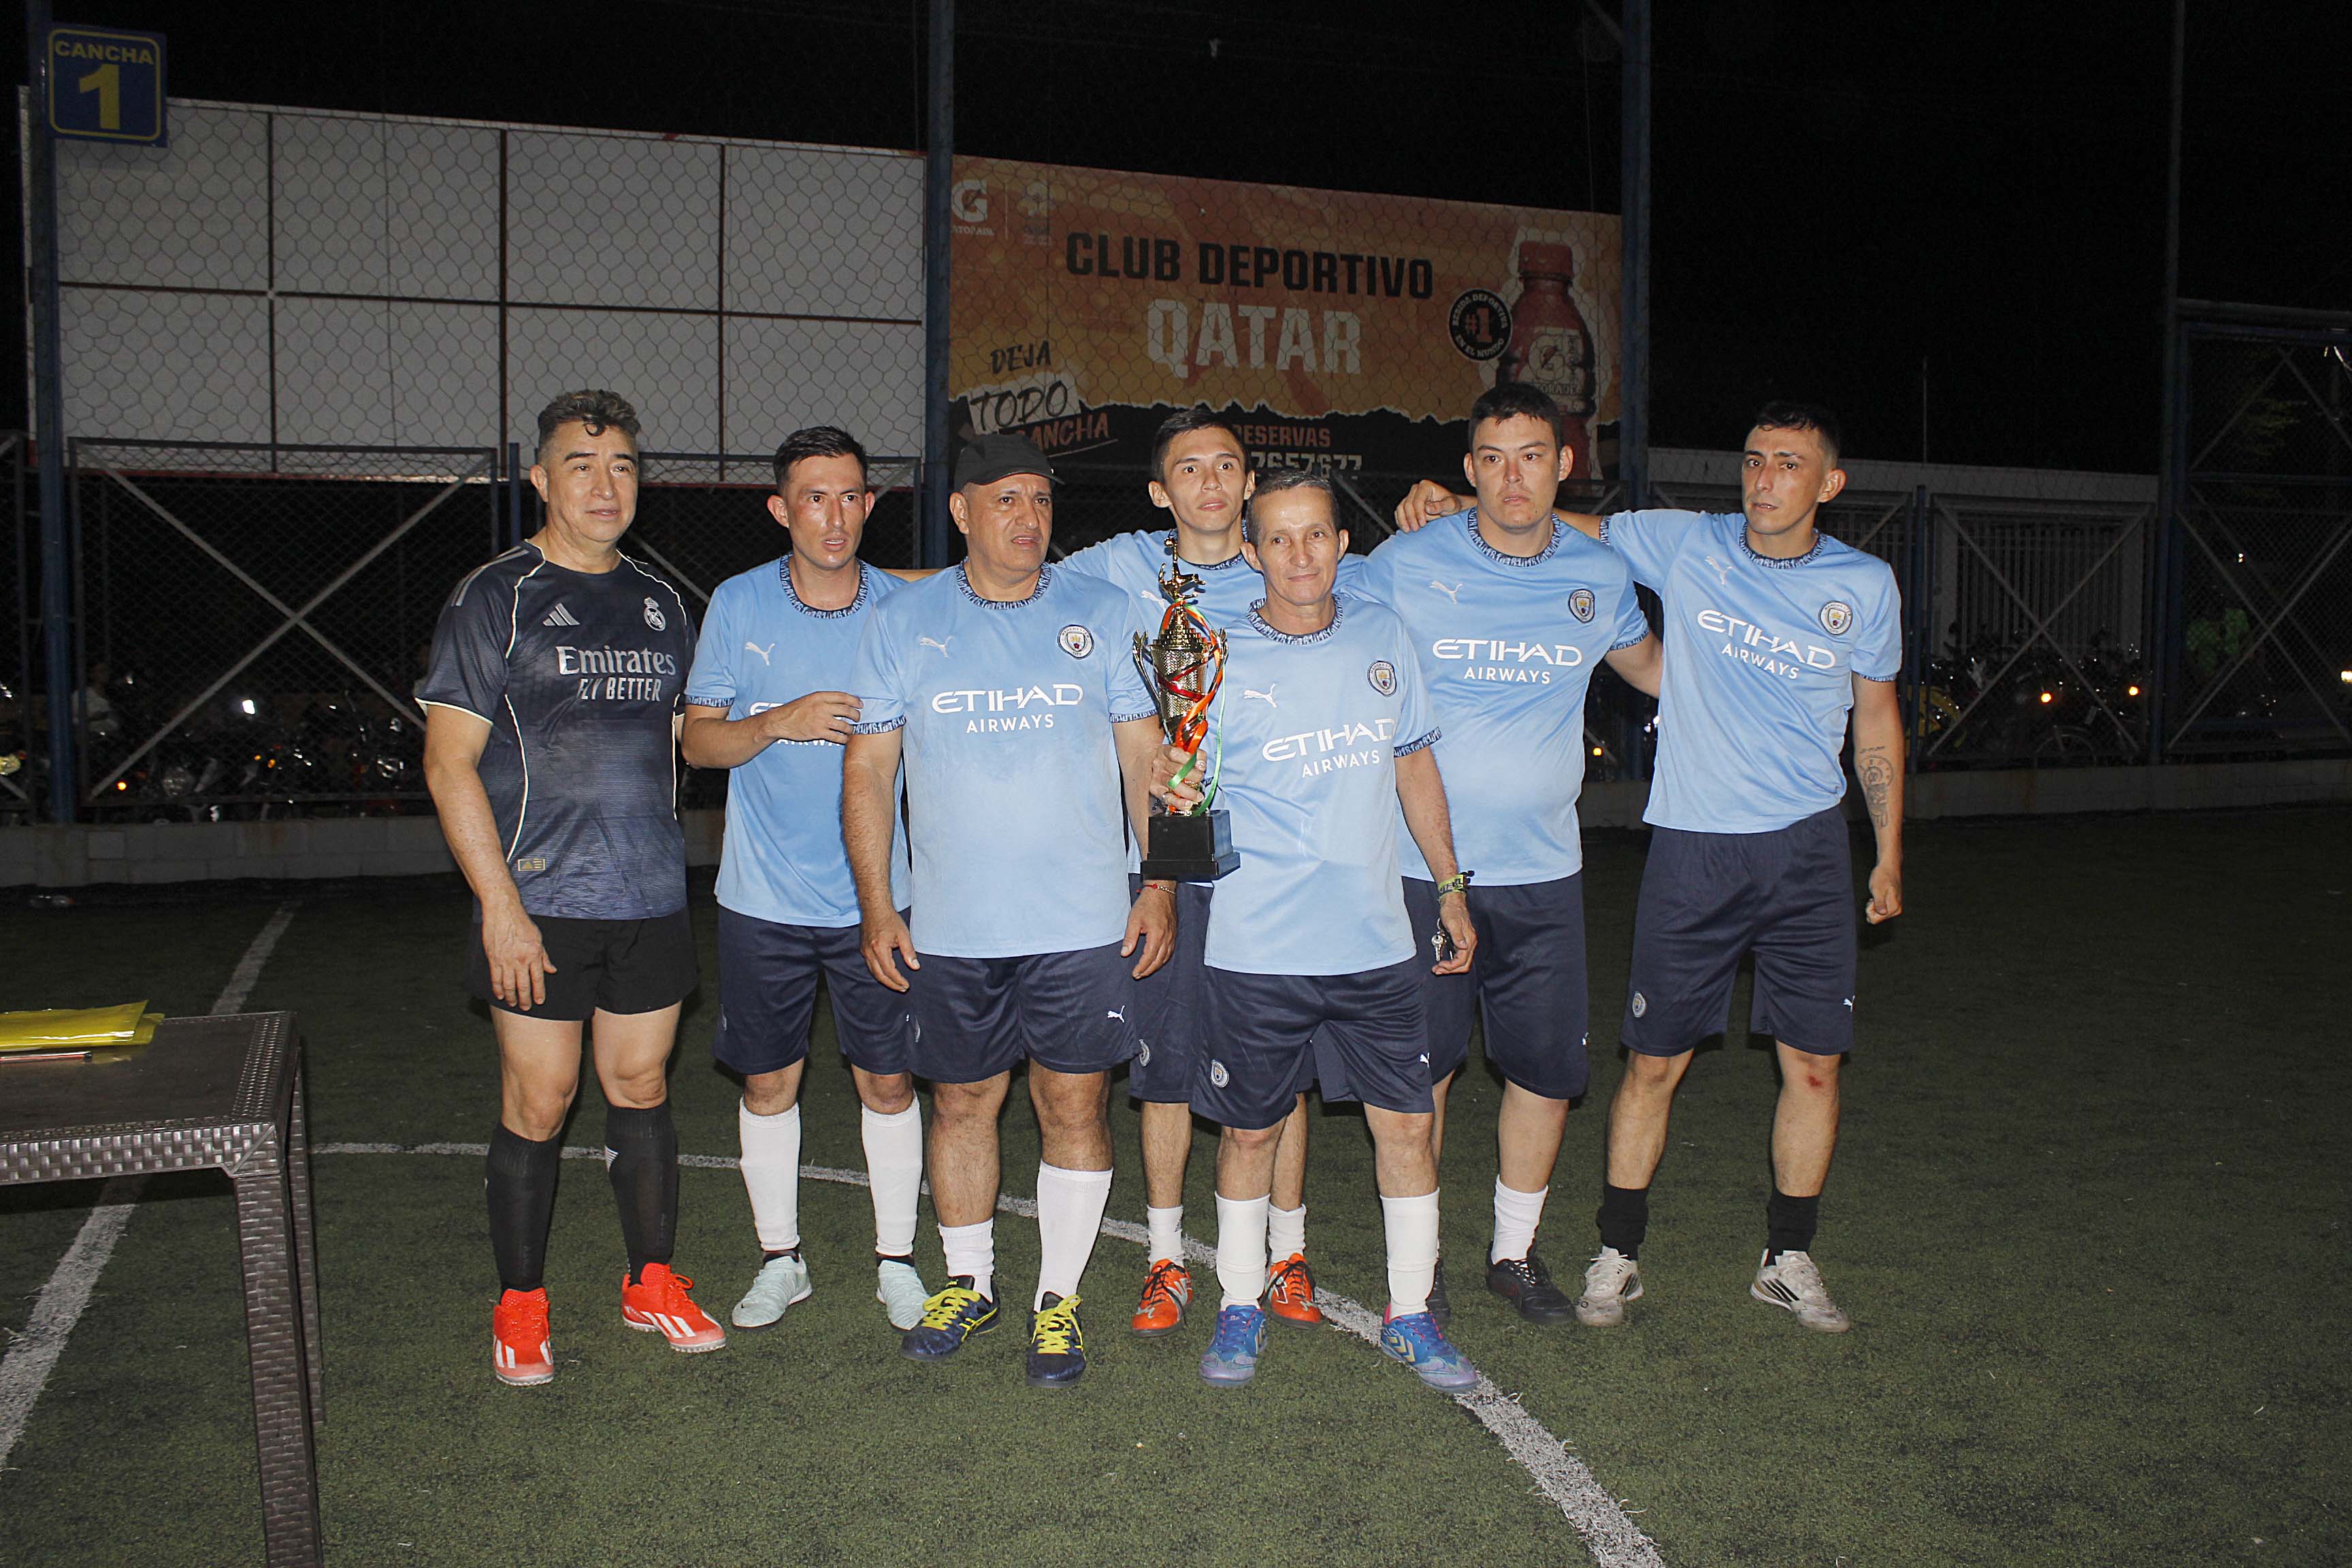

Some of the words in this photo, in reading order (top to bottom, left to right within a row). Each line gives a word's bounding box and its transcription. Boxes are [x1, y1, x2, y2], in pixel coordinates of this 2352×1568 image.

[55, 40, 154, 65] CANCHA
[79, 63, 120, 129] 1
[1066, 231, 1181, 281] CLUB
[1199, 242, 1434, 299] DEPORTIVO
[1147, 299, 1360, 379] QATAR
[1465, 306, 1492, 343] #1
[991, 340, 1051, 374] DEJA
[970, 380, 1068, 431] TODO
[1015, 413, 1107, 452] ANCHA
[1432, 638, 1582, 667] ETIHAD
[1697, 609, 1837, 669] ETIHAD
[555, 645, 676, 676] Emirates
[1464, 667, 1551, 685] AIRWAYS
[1722, 643, 1799, 680] AIRWAYS
[606, 676, 662, 702] BETTER
[932, 684, 1083, 714] ETIHAD
[966, 713, 1054, 734] AIRWAYS
[1262, 719, 1396, 762] ETIHAD
[1302, 750, 1380, 778] AIRWAYS
